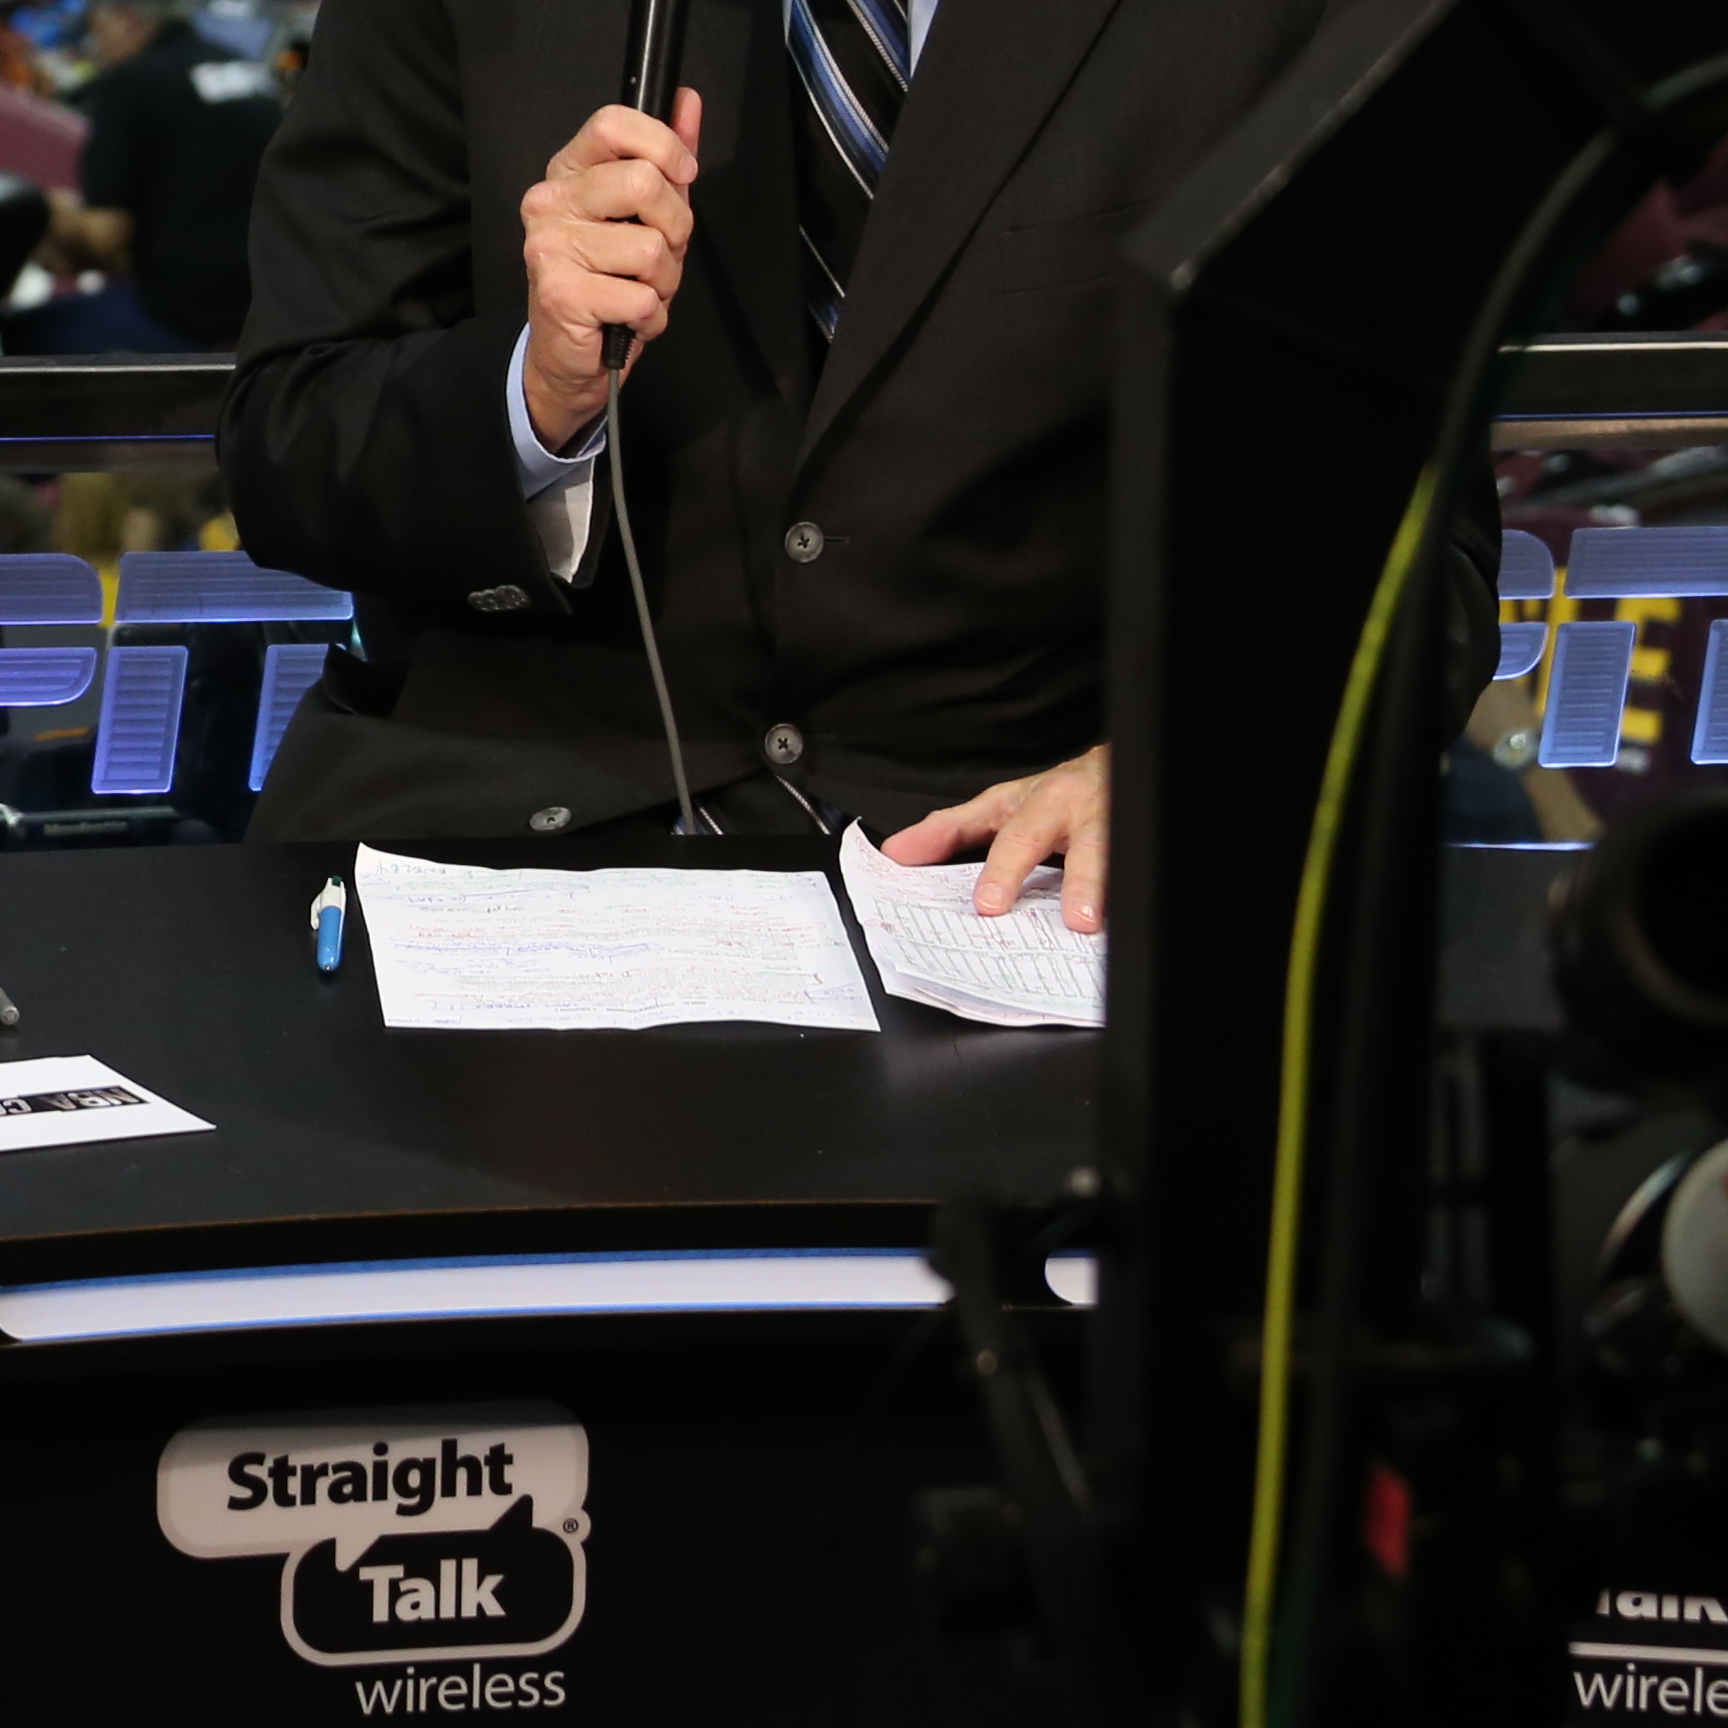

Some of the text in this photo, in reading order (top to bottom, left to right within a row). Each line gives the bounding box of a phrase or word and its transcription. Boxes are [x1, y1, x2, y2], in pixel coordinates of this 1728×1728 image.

[50, 1085, 144, 1111] NBA
[227, 1438, 515, 1517] Straight
[358, 1557, 506, 1624] Talk
[355, 1662, 567, 1716] wireless
